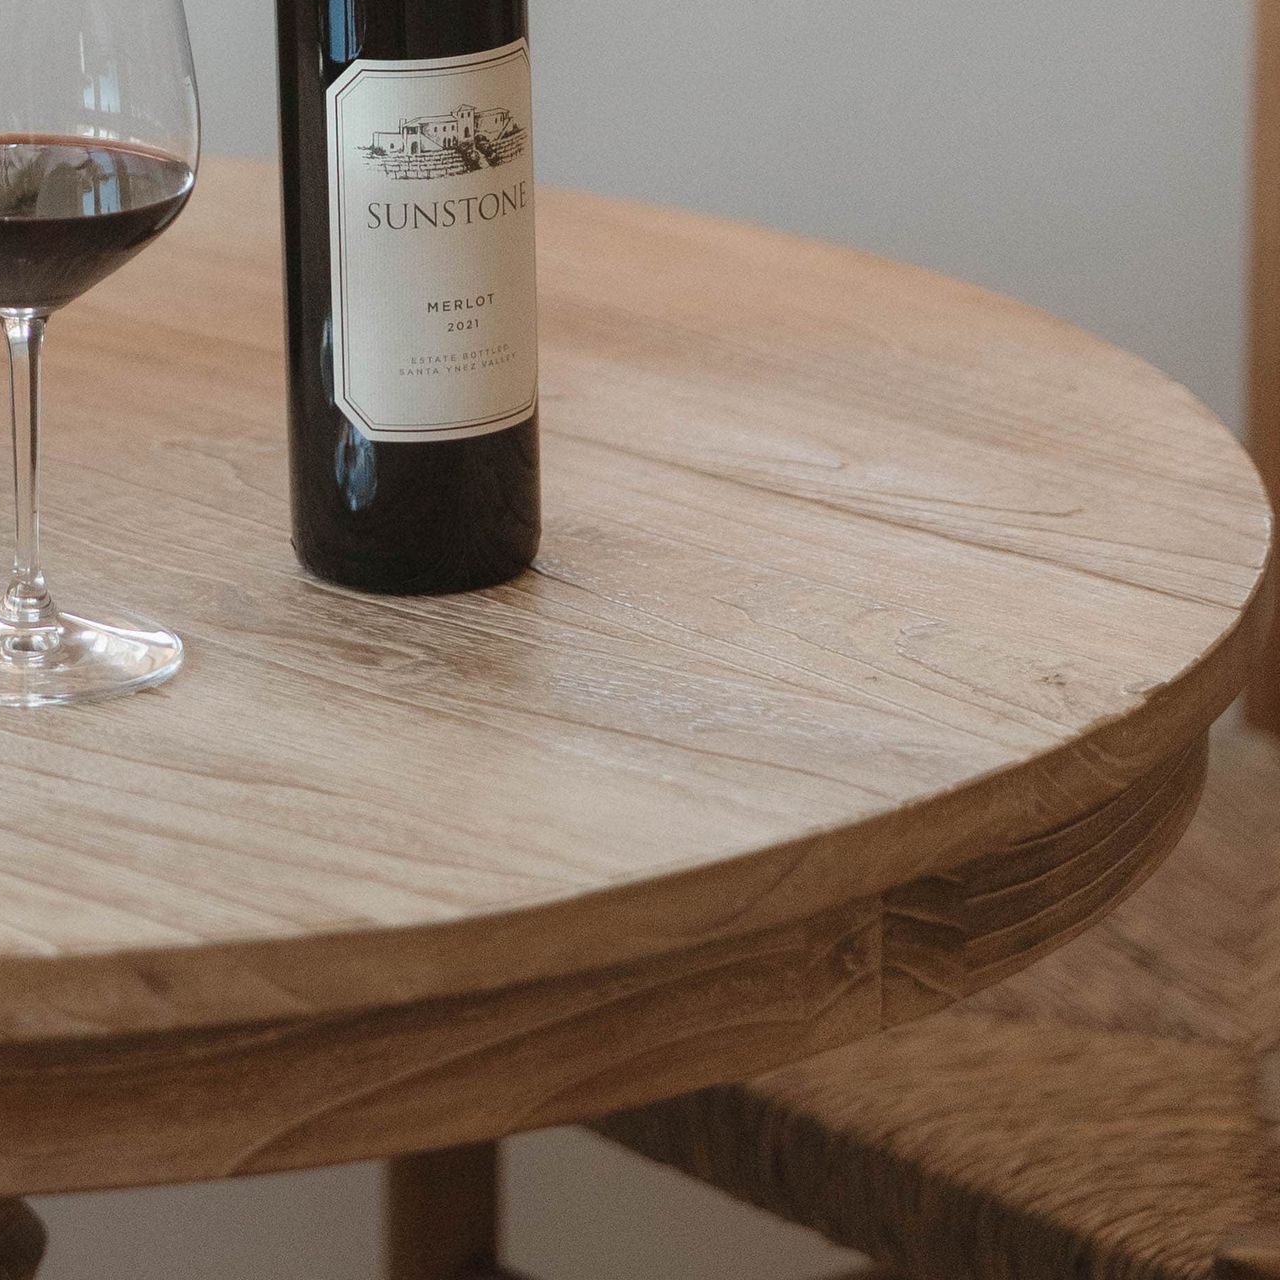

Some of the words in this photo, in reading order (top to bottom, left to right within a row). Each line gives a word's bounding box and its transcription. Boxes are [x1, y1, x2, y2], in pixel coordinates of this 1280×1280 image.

[367, 181, 527, 230] SUNSTONE
[427, 293, 495, 313] MERLOT
[447, 319, 480, 332] 2021
[399, 367, 439, 376] SANTA
[446, 363, 476, 373] YNEZ
[481, 351, 517, 368] VALLEY
[410, 354, 457, 365] ESTATE
[462, 343, 510, 360] BOTTLED
